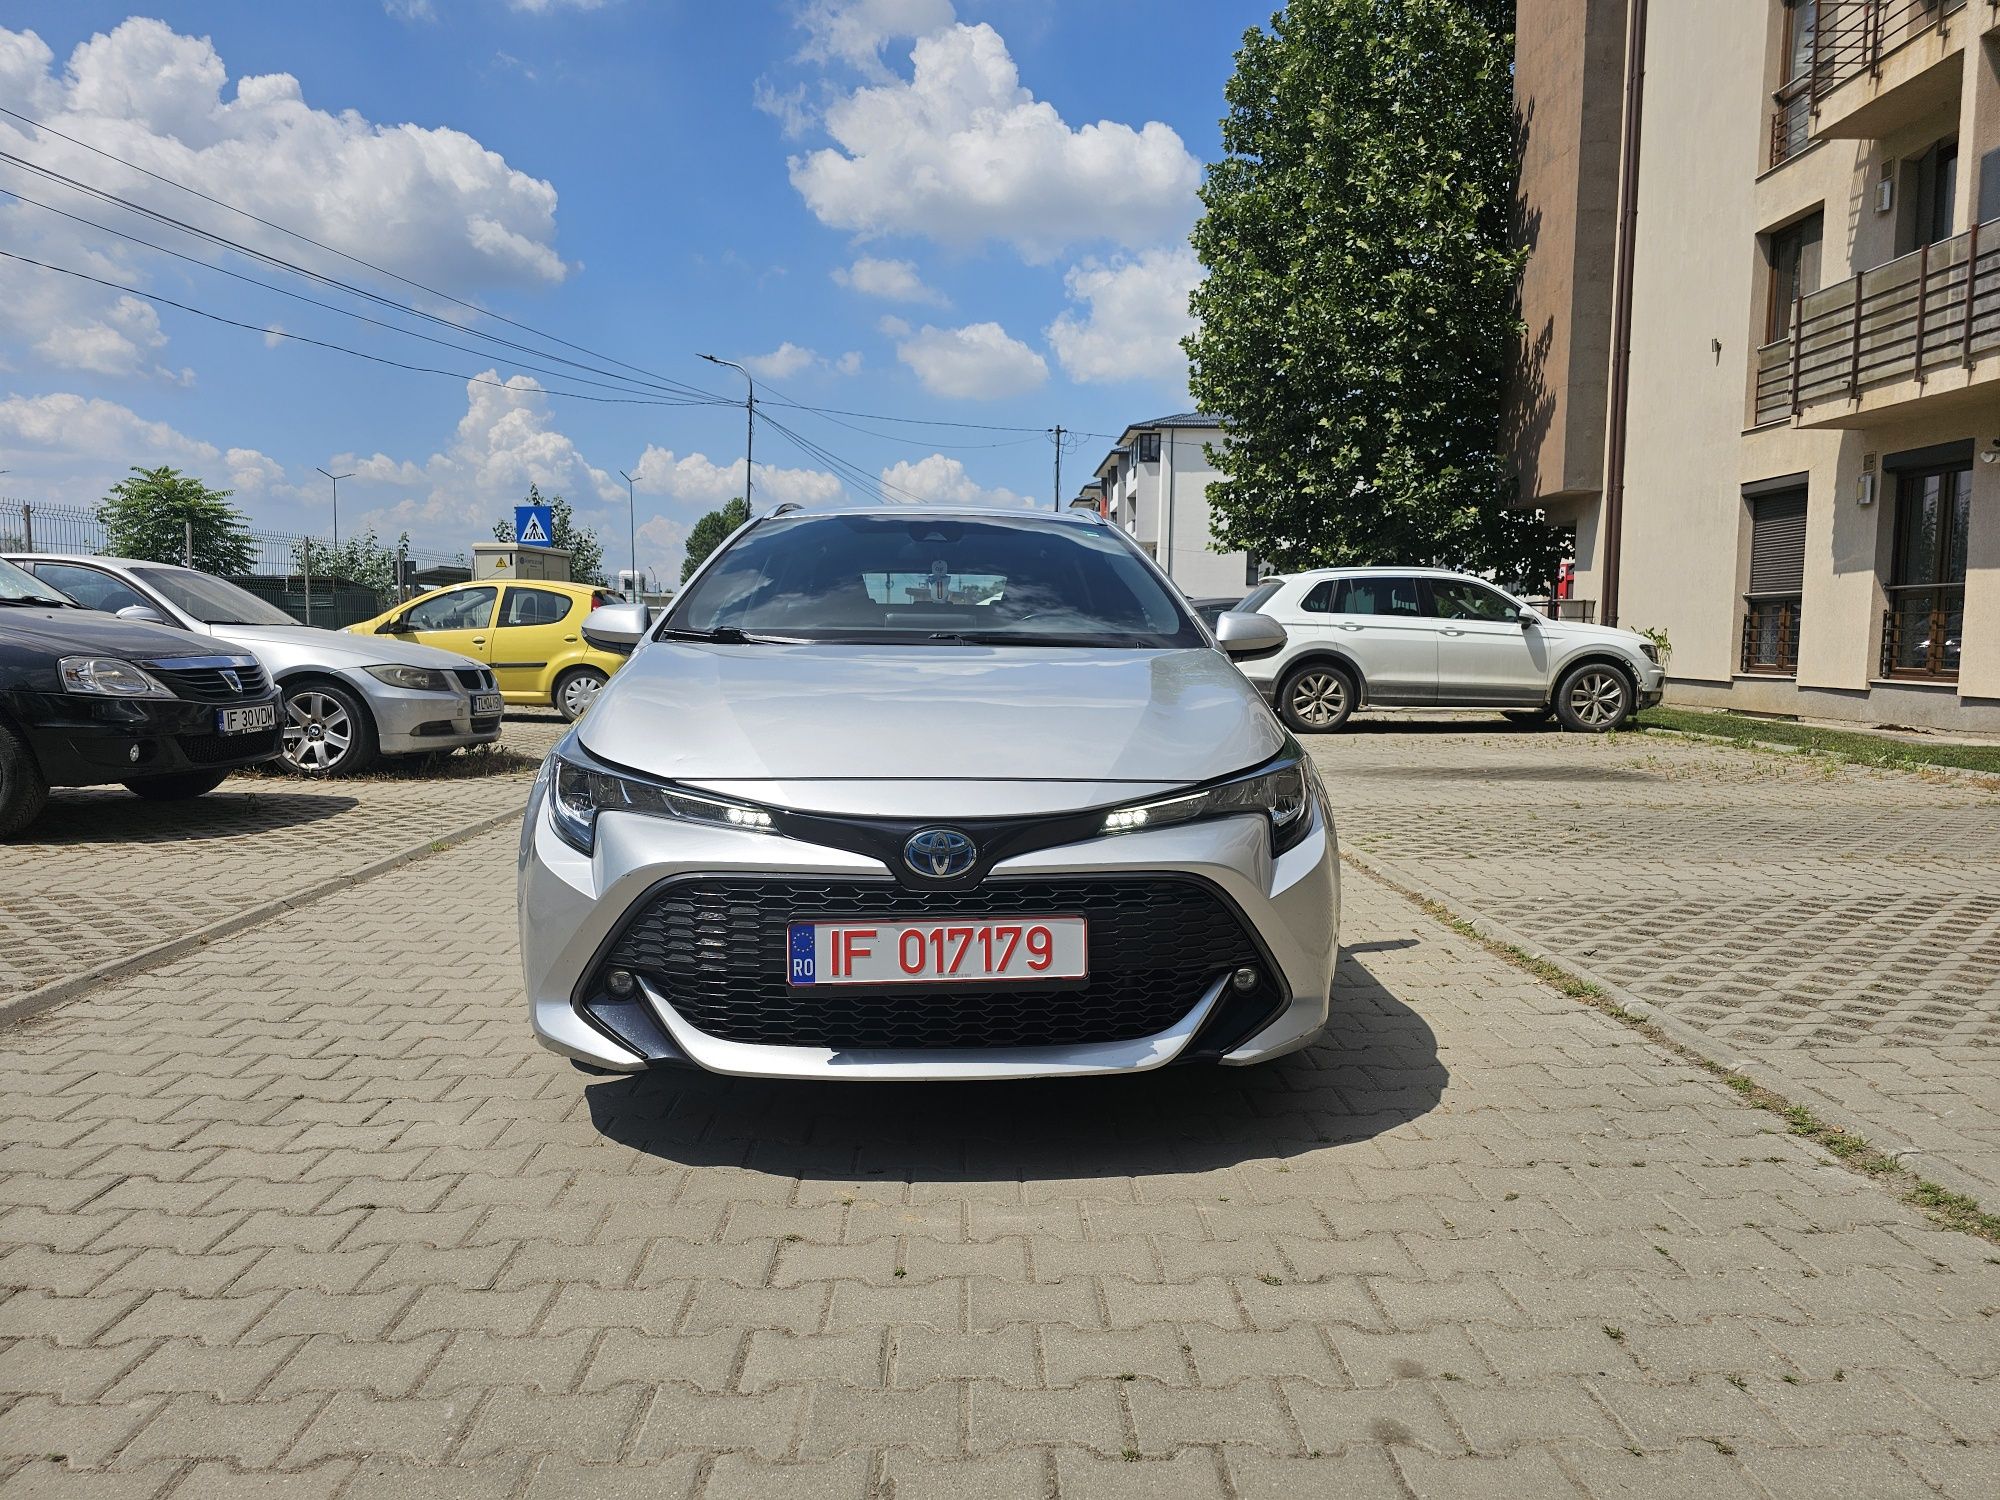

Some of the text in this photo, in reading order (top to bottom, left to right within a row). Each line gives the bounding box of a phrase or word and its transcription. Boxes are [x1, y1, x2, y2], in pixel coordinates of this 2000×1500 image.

[226, 711, 238, 730] IF
[831, 925, 1053, 977] IF 017179
[793, 958, 814, 977] RO
